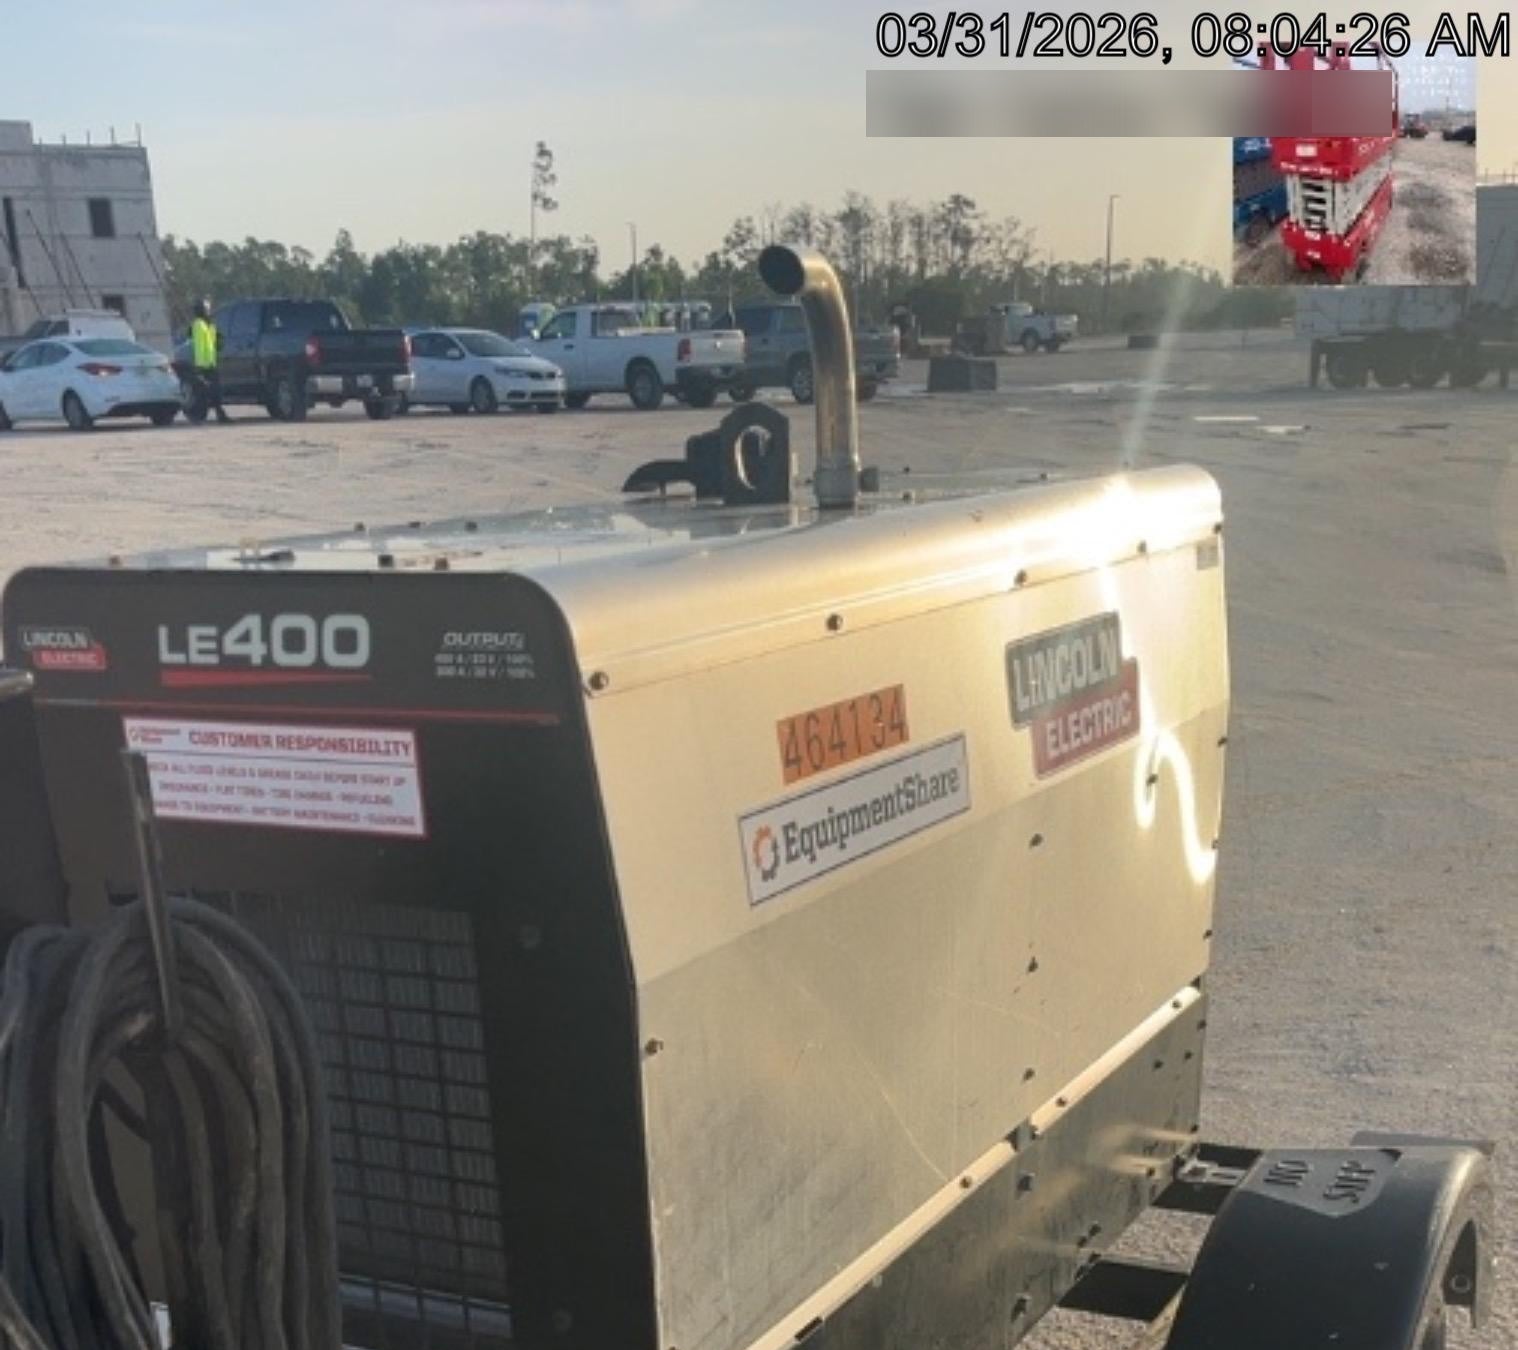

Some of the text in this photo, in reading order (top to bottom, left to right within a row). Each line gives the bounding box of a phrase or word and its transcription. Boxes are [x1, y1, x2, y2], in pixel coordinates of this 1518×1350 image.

[23, 630, 89, 648] LINCOLN
[158, 613, 371, 667] LE400
[1013, 628, 1118, 712] LINCOLN
[188, 730, 271, 749] CUSTOMER
[275, 735, 412, 757] RESPONSIBILITY
[783, 688, 907, 774] 464134
[1046, 690, 1132, 759] ELECTRIC
[782, 767, 961, 864] EquipmentShare
